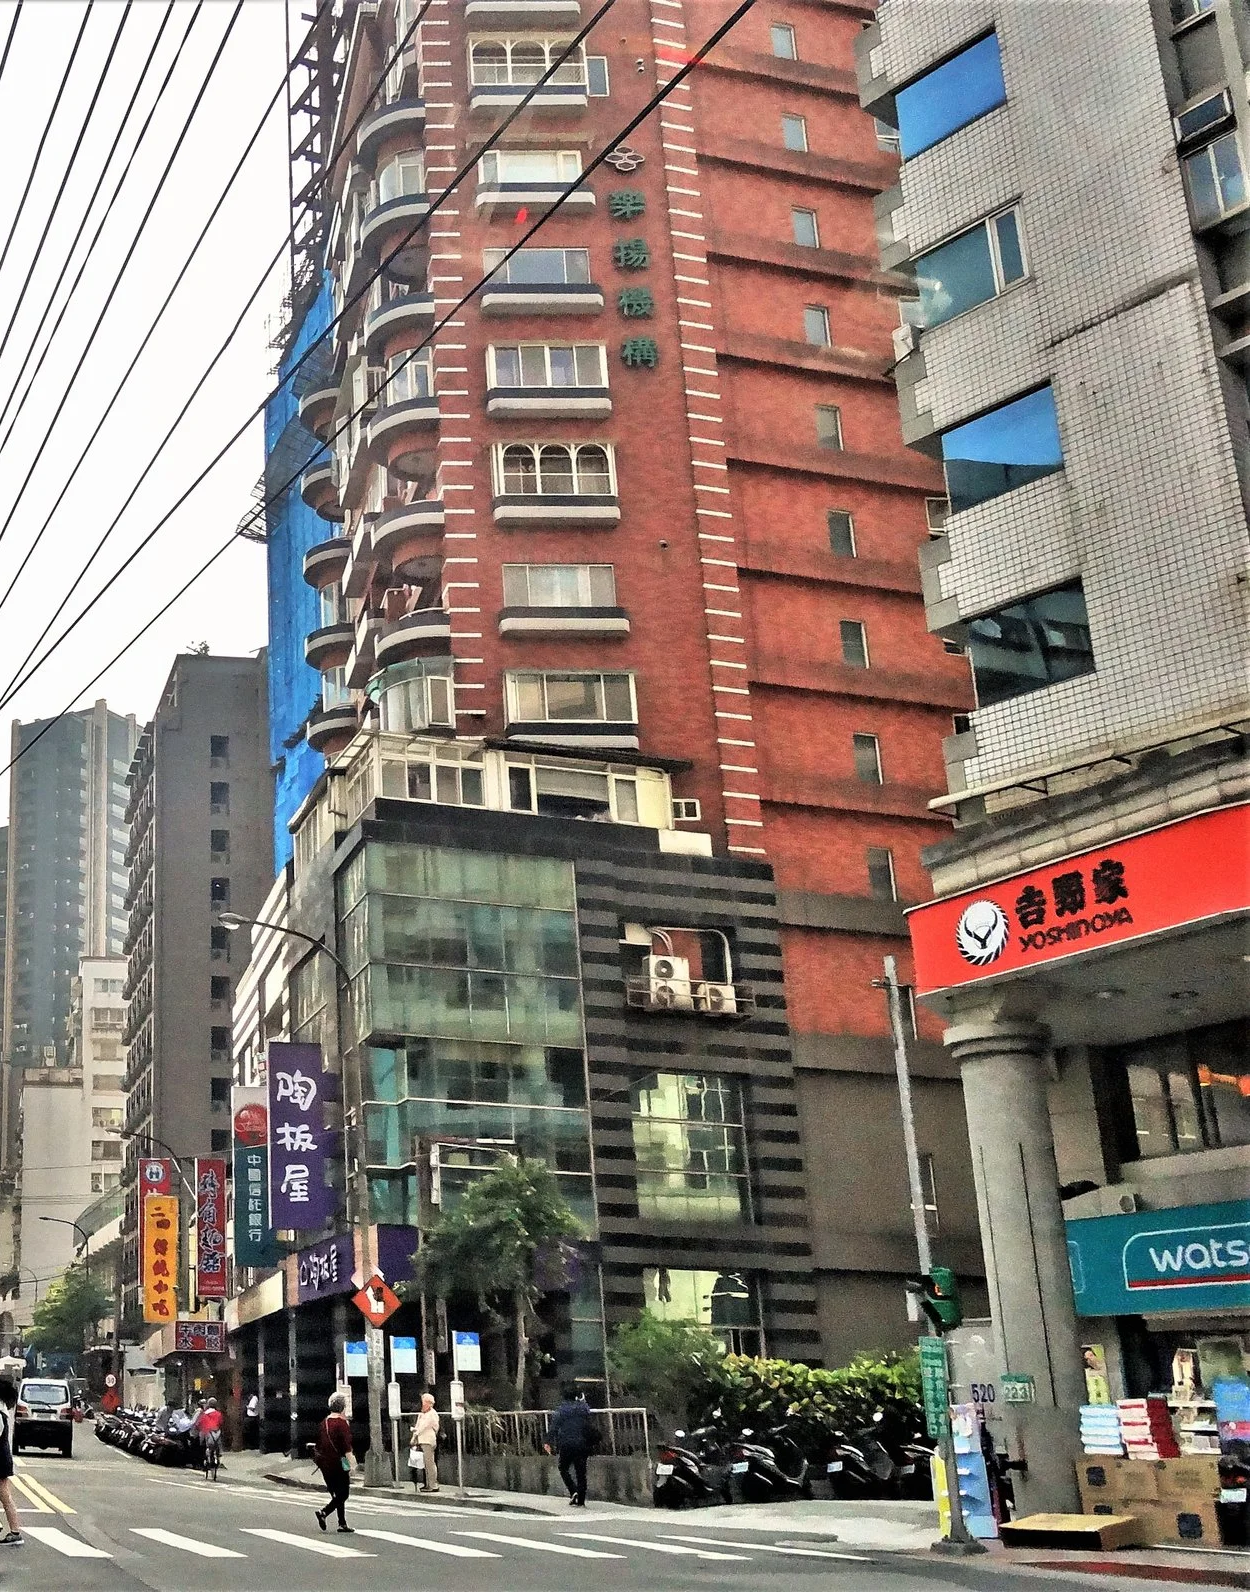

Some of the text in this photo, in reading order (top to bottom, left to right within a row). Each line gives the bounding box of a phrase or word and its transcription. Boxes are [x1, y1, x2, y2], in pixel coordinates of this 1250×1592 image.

[1015, 858, 1129, 929] 吉野家
[1017, 907, 1133, 952] YOSHINOYA
[276, 1070, 318, 1203] 陶板屋
[247, 1154, 261, 1242] 中國信託銀行
[1149, 1238, 1250, 1273] wats
[971, 1383, 996, 1403] 520
